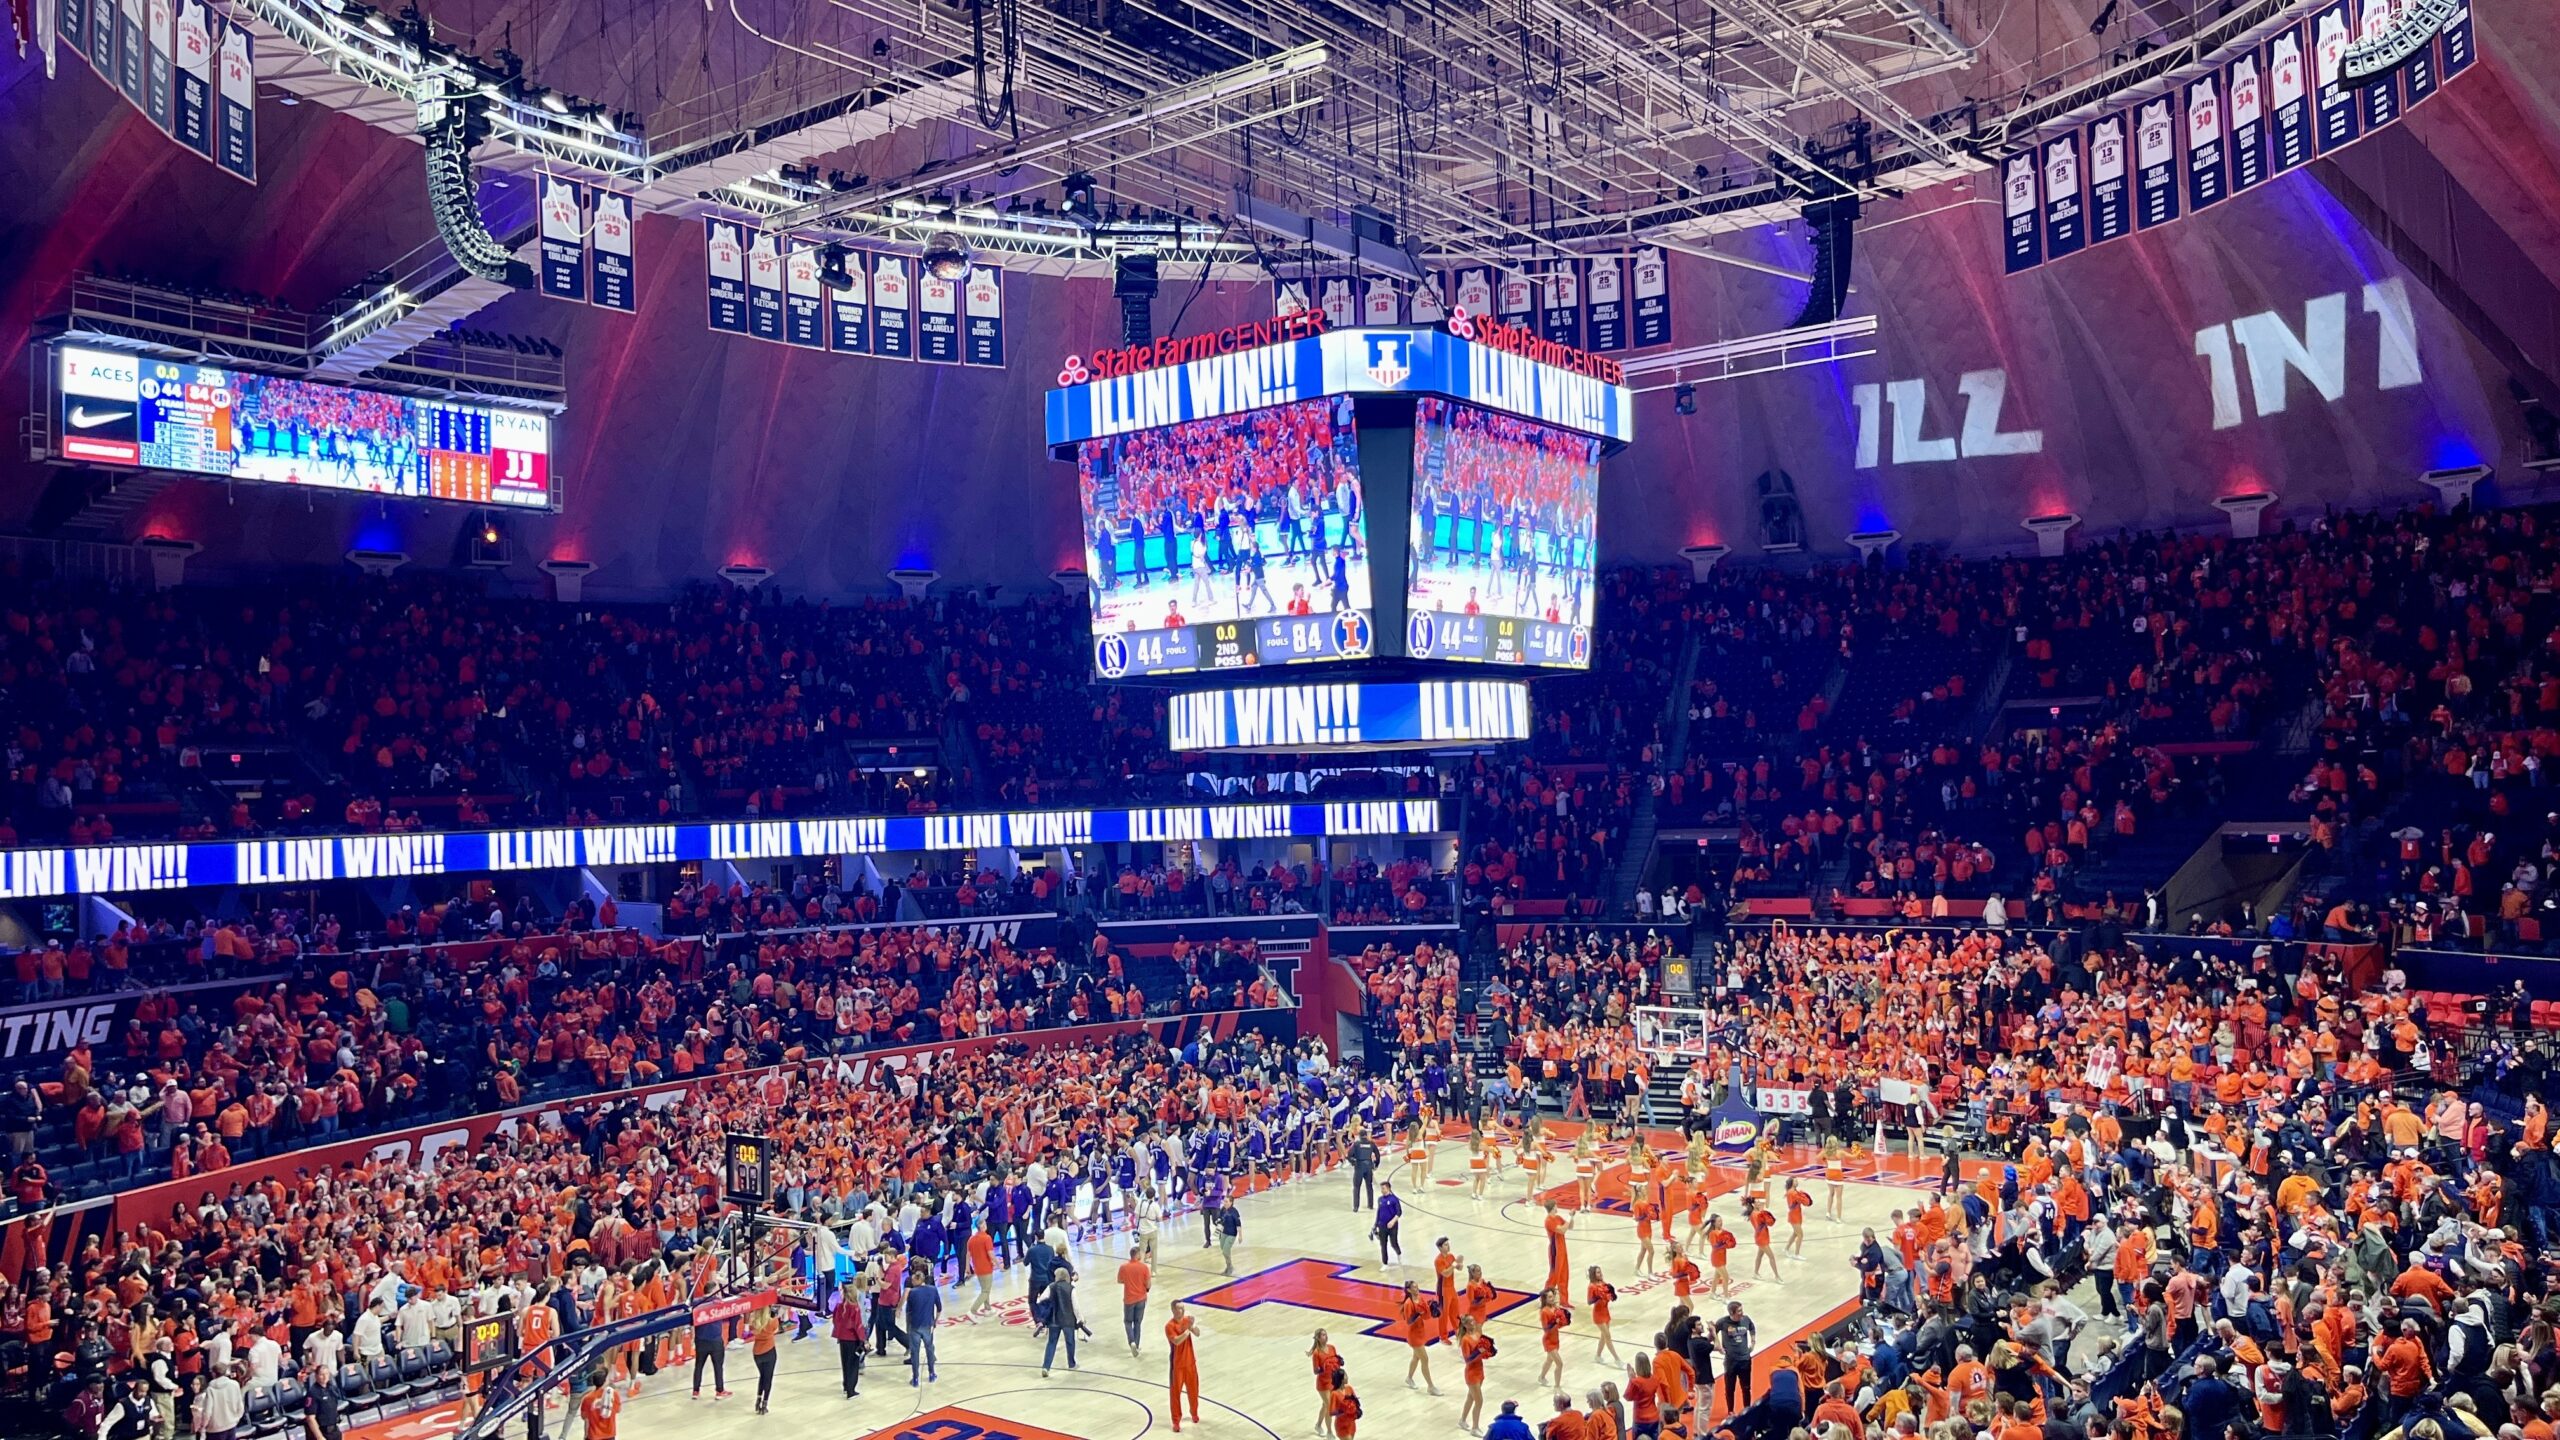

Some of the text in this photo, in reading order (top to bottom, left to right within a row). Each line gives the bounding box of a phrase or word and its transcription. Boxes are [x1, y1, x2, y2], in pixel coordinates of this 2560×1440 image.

[187, 35, 201, 54] 25
[2320, 32, 2343, 50] ILLINOIS
[2328, 46, 2336, 64] 5
[2274, 55, 2297, 74] ILLINOIS
[230, 64, 242, 82] 14
[2282, 69, 2292, 84] 4
[2234, 78, 2255, 95] ILLINOIS
[2191, 99, 2214, 116] ILLINOIS
[2236, 90, 2254, 110] 34
[2195, 111, 2212, 130] 30
[2149, 130, 2161, 142] 25
[2102, 148, 2113, 158] 13
[2196, 144, 2215, 160] FRANK
[2055, 166, 2066, 176] 25
[2015, 182, 2026, 192] 33
[605, 223, 621, 237] 33
[720, 251, 731, 263] 11
[797, 269, 811, 281] 22
[876, 274, 905, 287] ILLINOIS
[1599, 276, 1610, 285] 25
[1643, 269, 1655, 279] 33
[883, 282, 898, 294] 30
[930, 287, 945, 298] 23
[968, 284, 997, 296] ILLINOIS
[976, 292, 990, 303] 40
[1467, 292, 1481, 304] 12
[1374, 301, 1388, 312] 15
[879, 319, 905, 329] JACKSON
[930, 316, 947, 327] JERRY
[1217, 308, 1326, 353] CENTER
[156, 364, 180, 381] 0.0
[1561, 344, 1624, 386] CENTER
[91, 366, 134, 383] ACES
[161, 382, 183, 398] 44
[189, 385, 210, 402] 84
[1090, 341, 1297, 438] ILLINI WIN!!!
[1469, 342, 1605, 436] ILLINI WIN!!!
[495, 414, 542, 433] RYAN
[1272, 621, 1282, 637] 6
[1467, 617, 1474, 632] 4
[1499, 621, 1513, 637] 0.0
[1534, 625, 1542, 639] 6
[1171, 630, 1180, 645] 4
[1216, 625, 1236, 641] 0.0
[1292, 623, 1323, 653] 84
[1343, 620, 1361, 650] I
[1415, 620, 1428, 648] N
[1440, 620, 1461, 651] 44
[1462, 635, 1479, 644] FOULS
[1216, 643, 1239, 656] 2ND
[1266, 636, 1289, 648] FOULS
[1497, 638, 1513, 650] 2ND
[1529, 640, 1544, 649] FOULS
[1545, 630, 1564, 658] 84
[1573, 634, 1583, 658] I
[1105, 639, 1121, 668] N
[1137, 636, 1163, 665] 44
[1166, 646, 1187, 656] FOULS
[1495, 651, 1515, 662] POSS
[1214, 655, 1243, 667] POSS
[1232, 685, 1361, 746] WIN!!!
[1419, 682, 1513, 740] ILLINI
[1127, 804, 1291, 842] ILLINI WIN!!!
[1324, 801, 1399, 837] ILLINI
[709, 818, 887, 860] ILLINI WIN!!!
[923, 811, 1093, 851] ILLINI WIN!!!
[488, 825, 677, 871] ILLINI WIN!!!
[237, 834, 445, 885] ILLINI WIN!!!
[74, 844, 189, 894] WIN!!!
[0, 1003, 117, 1058] TING
[1764, 1093, 1774, 1108] 3
[1781, 1094, 1790, 1108] 3
[1797, 1095, 1807, 1110] 3
[1715, 1125, 1752, 1141] LIBMAN
[532, 1316, 542, 1330] 0
[557, 1354, 591, 1381] LEGACY
